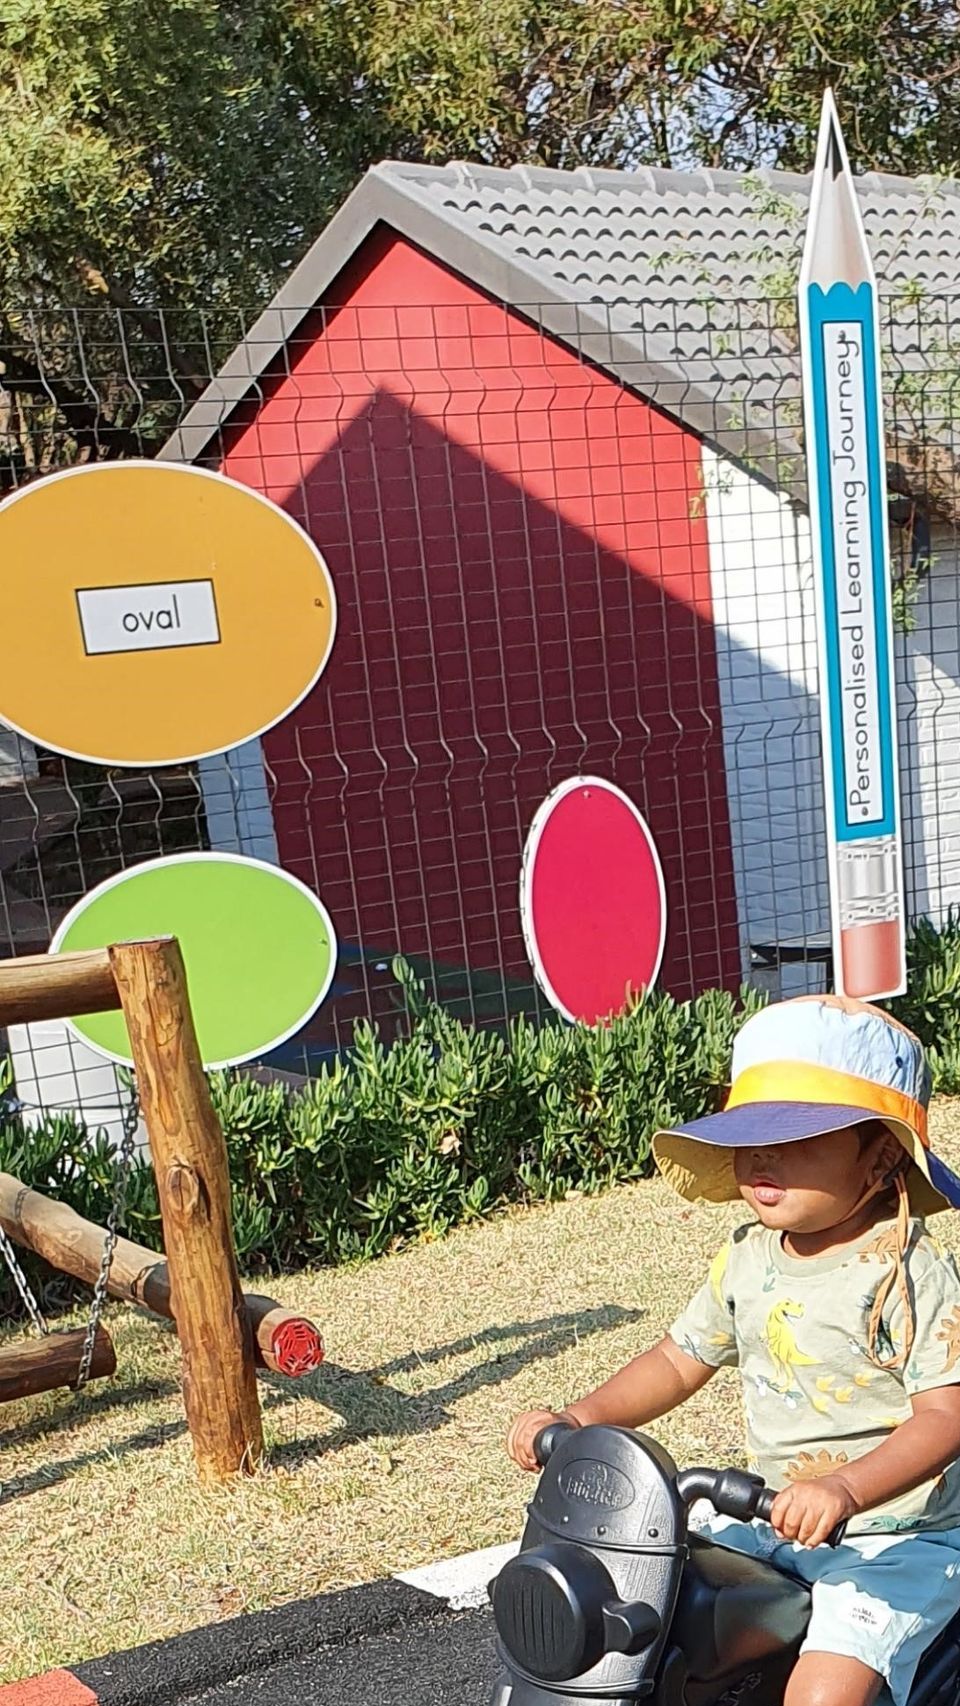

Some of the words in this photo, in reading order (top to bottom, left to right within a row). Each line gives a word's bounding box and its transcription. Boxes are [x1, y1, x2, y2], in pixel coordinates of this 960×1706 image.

[832, 337, 860, 472] Journey
[122, 593, 181, 632] oval
[839, 480, 867, 615] Learning
[840, 625, 871, 807] Personalised
